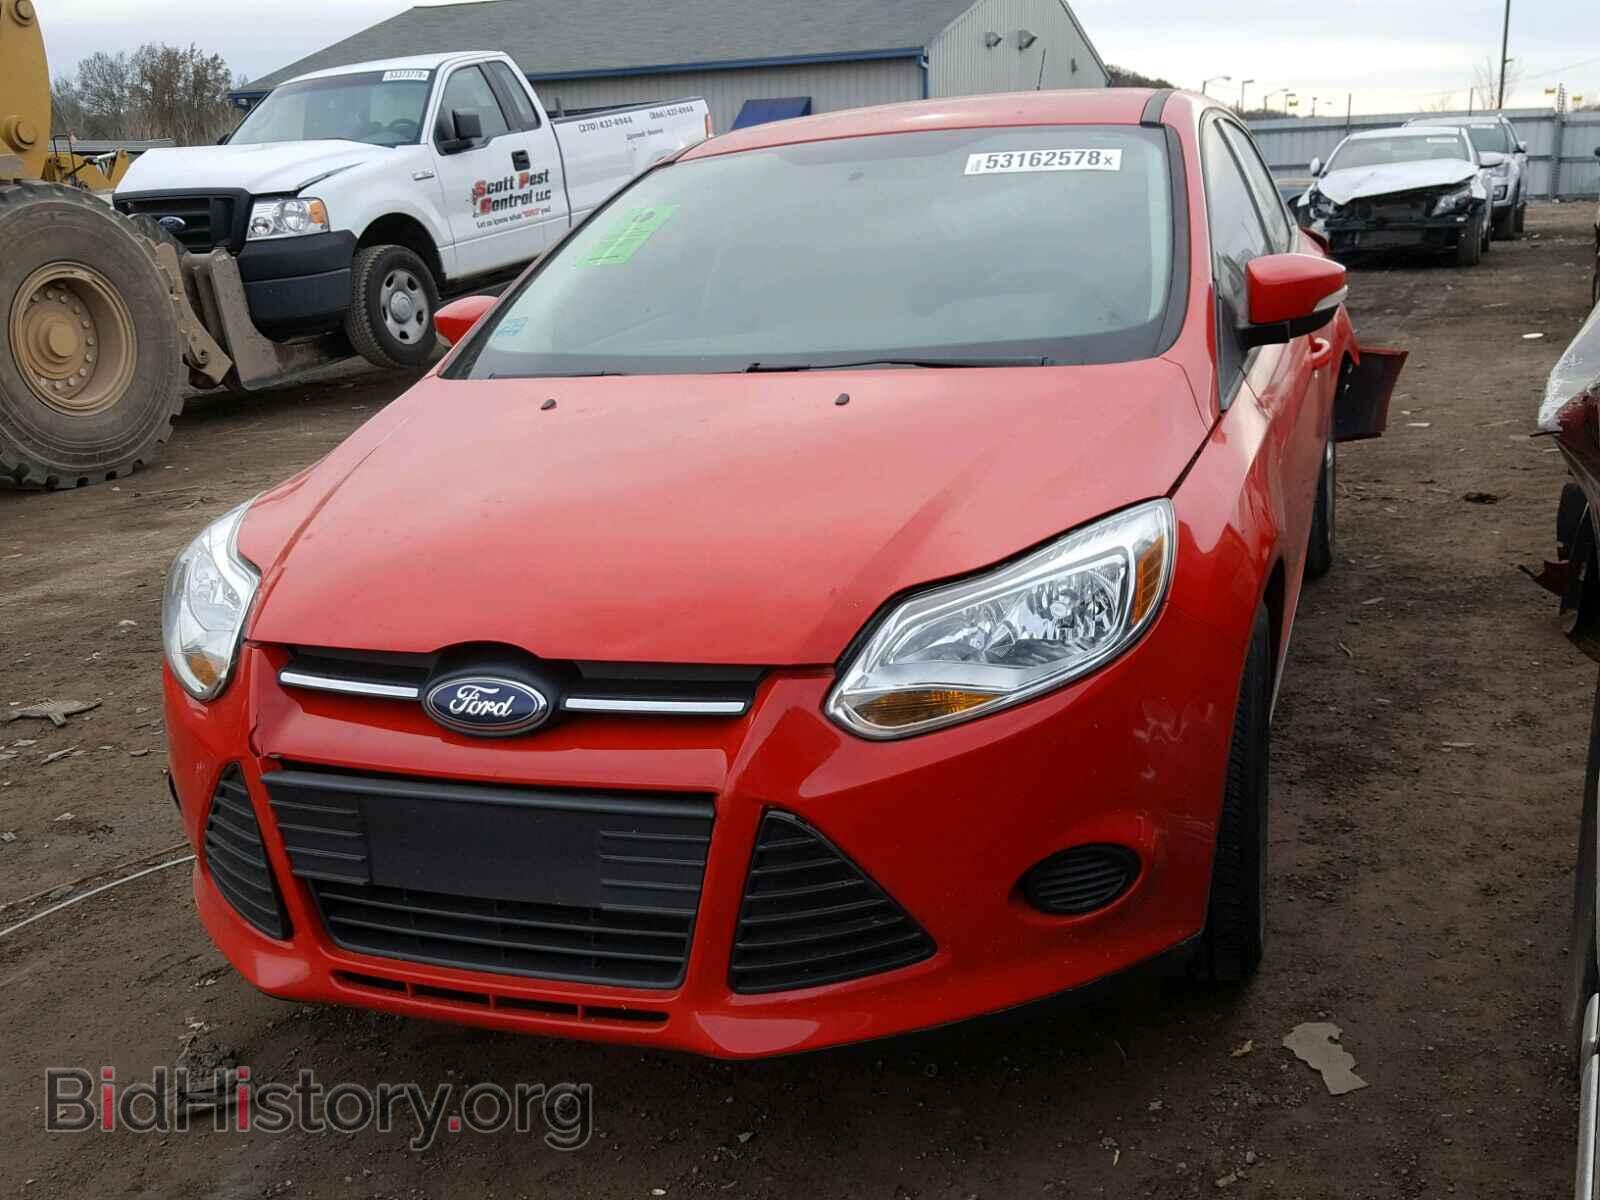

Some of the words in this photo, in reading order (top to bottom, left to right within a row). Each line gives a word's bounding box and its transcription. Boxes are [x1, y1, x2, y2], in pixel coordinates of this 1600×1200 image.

[985, 151, 1101, 169] 53162578
[475, 176, 514, 197] Scott
[519, 169, 549, 189] Pest
[480, 189, 533, 215] Control
[535, 189, 552, 202] LLC
[449, 685, 515, 717] Ford
